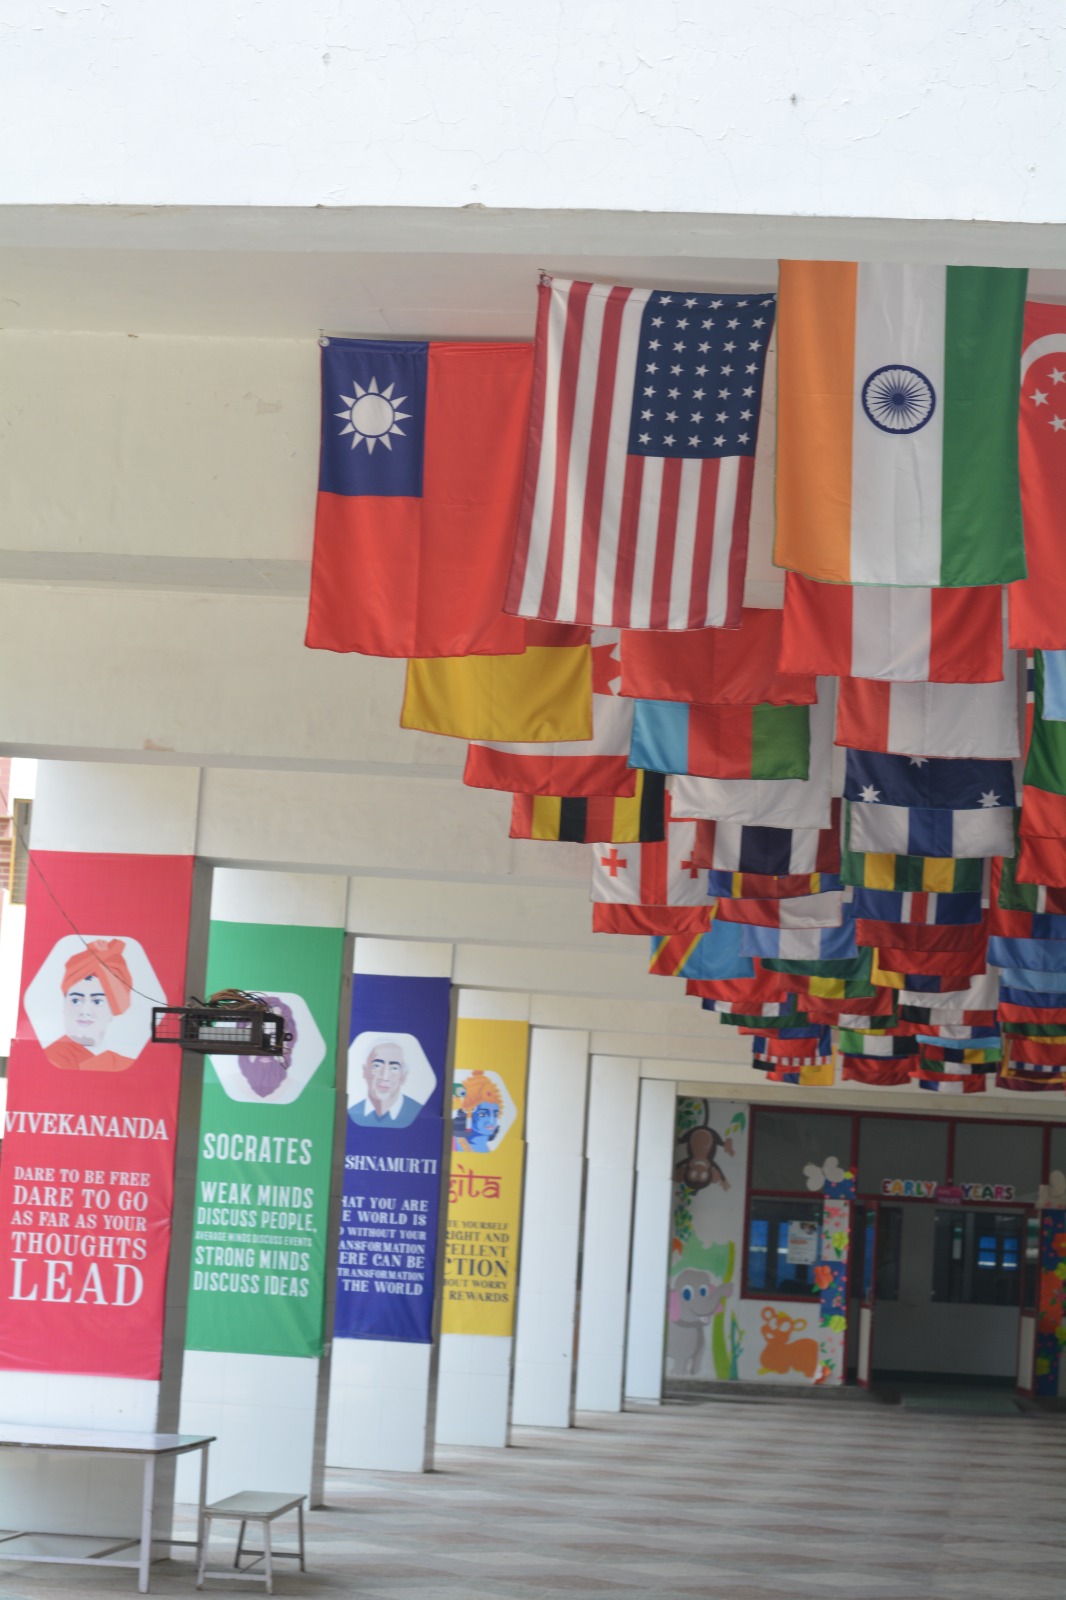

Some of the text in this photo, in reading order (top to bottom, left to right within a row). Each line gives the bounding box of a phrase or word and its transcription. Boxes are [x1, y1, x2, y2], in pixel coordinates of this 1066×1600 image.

[5, 1111, 169, 1140] VIVEKANANDA
[202, 1132, 313, 1165] SOCRATES
[14, 1166, 150, 1186] DARE TO BE FREE
[12, 1185, 148, 1211] DARE TO GO
[200, 1181, 315, 1209] WEAK MINDS
[882, 1179, 936, 1197] EARLY
[961, 1182, 1015, 1202] YEARS
[369, 1196, 397, 1210] YOU
[401, 1199, 429, 1212] ARE
[10, 1210, 148, 1231] AS FAR AS YOUR
[197, 1206, 258, 1228] DISCUSS
[357, 1210, 408, 1225] WORLD
[412, 1213, 427, 1226] IS
[347, 1226, 397, 1239] WITHOUT
[399, 1229, 427, 1240] YOUR
[485, 1232, 510, 1243] AND
[11, 1231, 148, 1260] THOUGHTS
[194, 1245, 310, 1271] STRONG MINDS
[339, 1251, 425, 1269] ERE CAN BE
[8, 1258, 144, 1306] LEAD
[193, 1270, 310, 1297] DISCUSS IDEAS
[336, 1267, 425, 1281] TRANSFORMATION
[341, 1278, 424, 1296] THE WORLD
[448, 1290, 510, 1303] REWARDS
